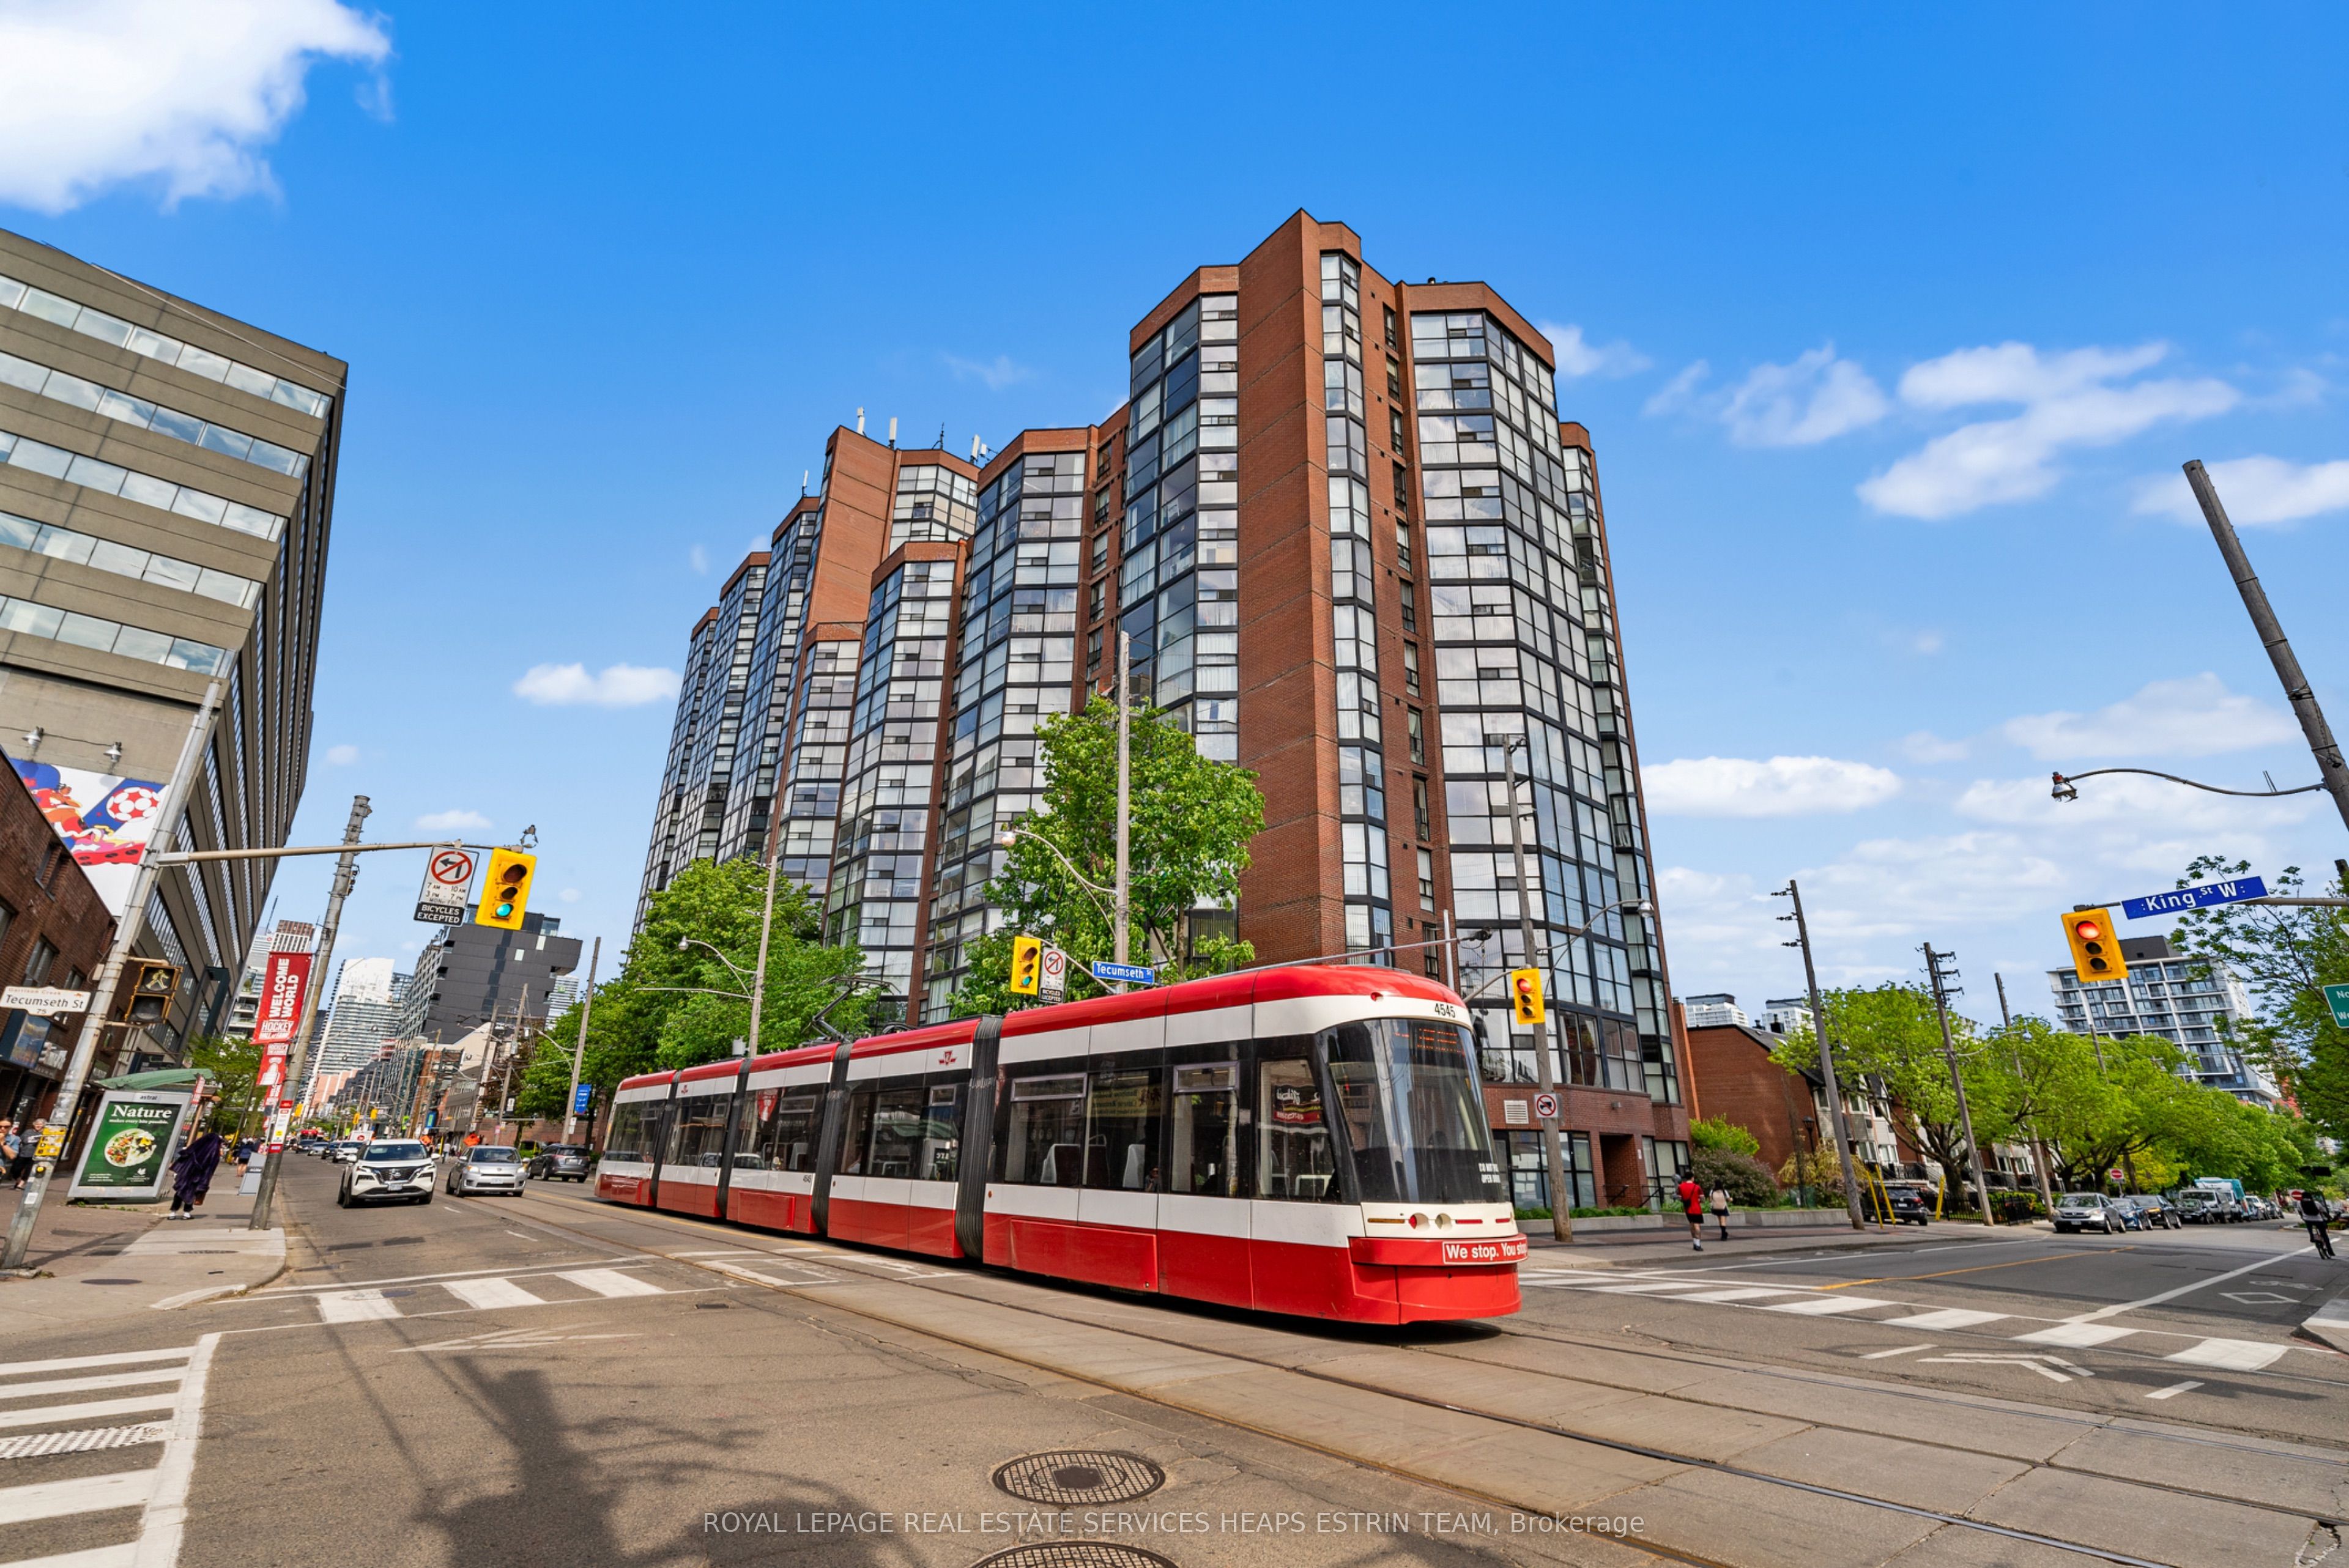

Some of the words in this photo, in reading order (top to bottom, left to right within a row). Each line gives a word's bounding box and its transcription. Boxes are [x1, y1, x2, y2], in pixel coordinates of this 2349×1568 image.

[2146, 892, 2197, 911] King
[2200, 886, 2213, 895] St
[2217, 882, 2237, 898] W
[421, 904, 459, 915] BICYCLES
[417, 912, 459, 923] EXCEPTED
[1097, 963, 1144, 979] Tecumseth
[269, 958, 290, 1018] WELCOME
[6, 994, 68, 1008] Tecumseth
[72, 999, 84, 1008] St
[281, 975, 299, 1018] WORLD
[1434, 1003, 1455, 1018] 4545
[261, 1021, 294, 1032] HOCKEY
[111, 1104, 173, 1119] Nature
[1445, 1244, 1468, 1259] We
[1471, 1245, 1499, 1261] stop.
[1501, 1242, 1516, 1257] You
